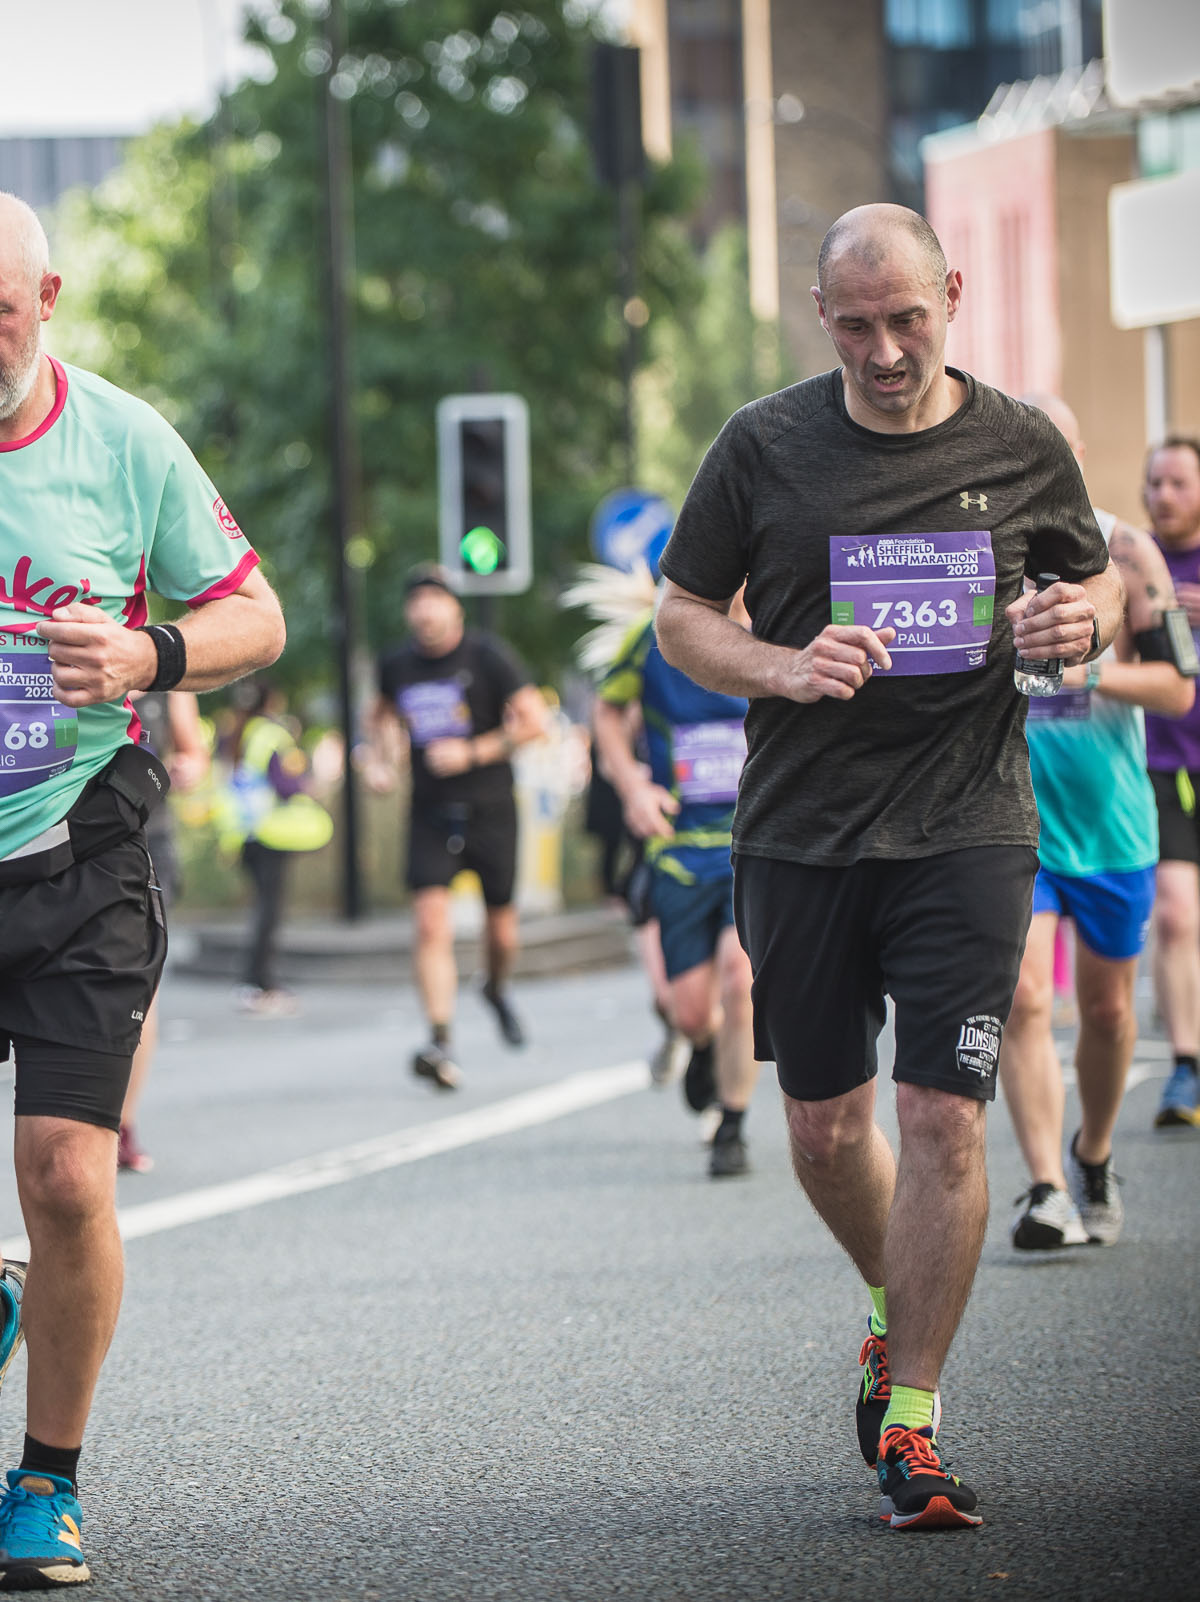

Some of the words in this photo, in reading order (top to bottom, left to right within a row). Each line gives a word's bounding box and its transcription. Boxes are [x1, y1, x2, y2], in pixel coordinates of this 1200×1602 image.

[878, 544, 933, 555] SHEFFIELD
[878, 555, 908, 566] HALF
[909, 553, 977, 565] MARATHON
[947, 564, 979, 576] 2020
[968, 583, 985, 594] XL
[871, 599, 958, 629] 7363
[12, 633, 49, 648] Hos
[897, 632, 934, 645] PAUL
[25, 686, 54, 698] 2020
[51, 706, 60, 717] L
